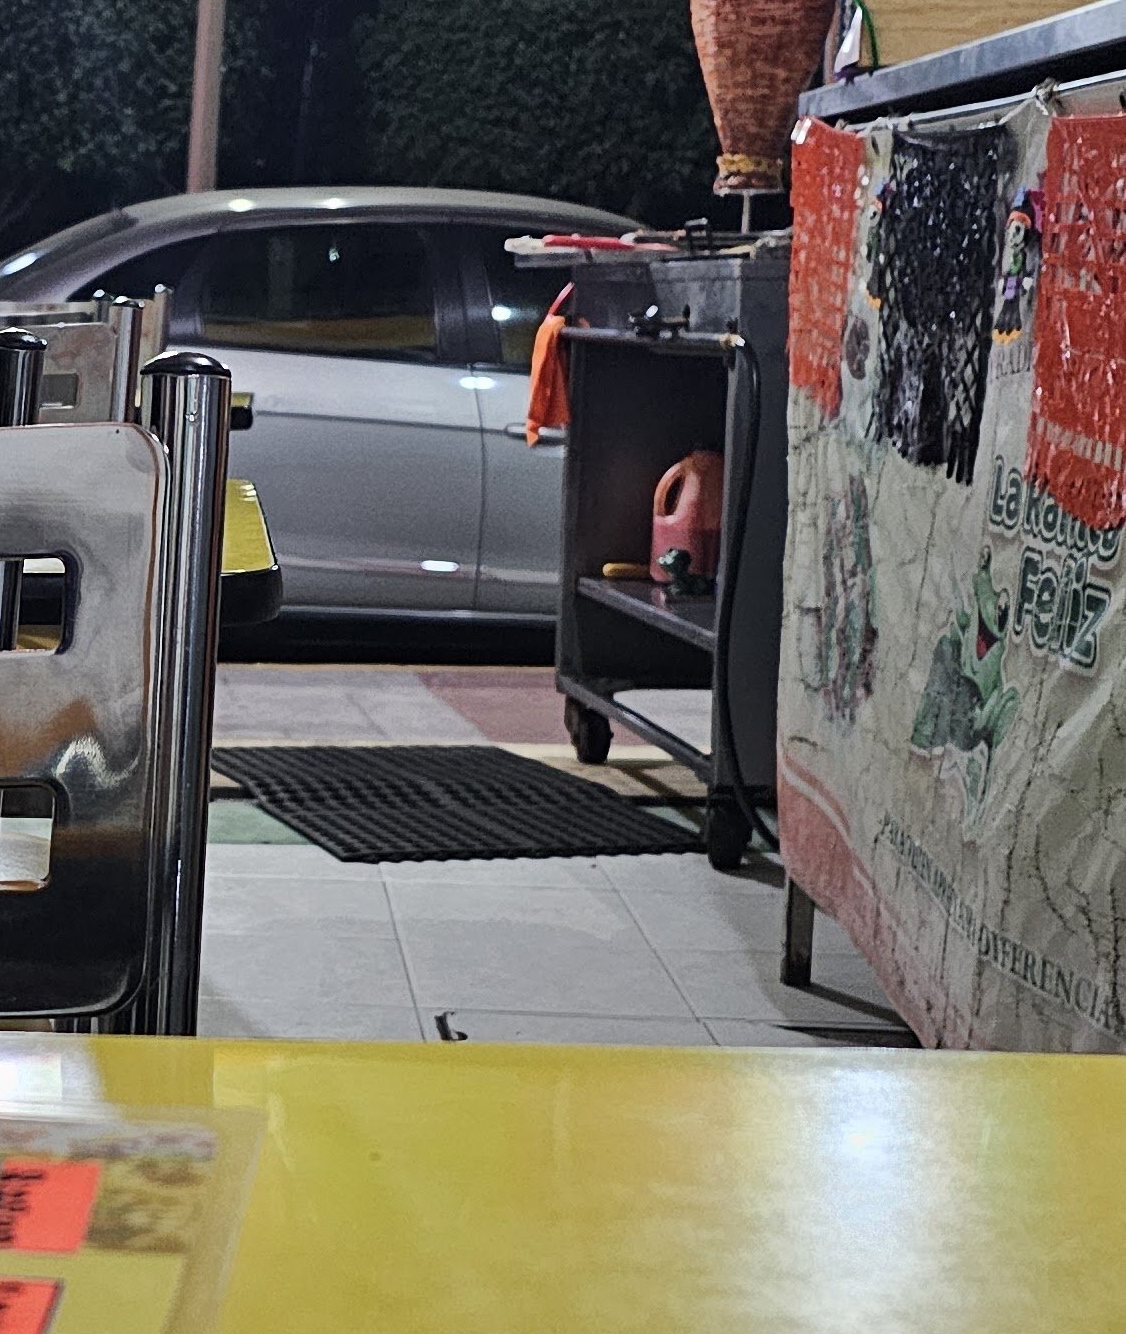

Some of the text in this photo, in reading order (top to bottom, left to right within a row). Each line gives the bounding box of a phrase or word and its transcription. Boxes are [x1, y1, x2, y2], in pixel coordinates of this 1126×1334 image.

[989, 454, 1022, 530] La
[1013, 545, 1111, 668] Feliz
[978, 923, 1119, 1034] DIFERENCIA
